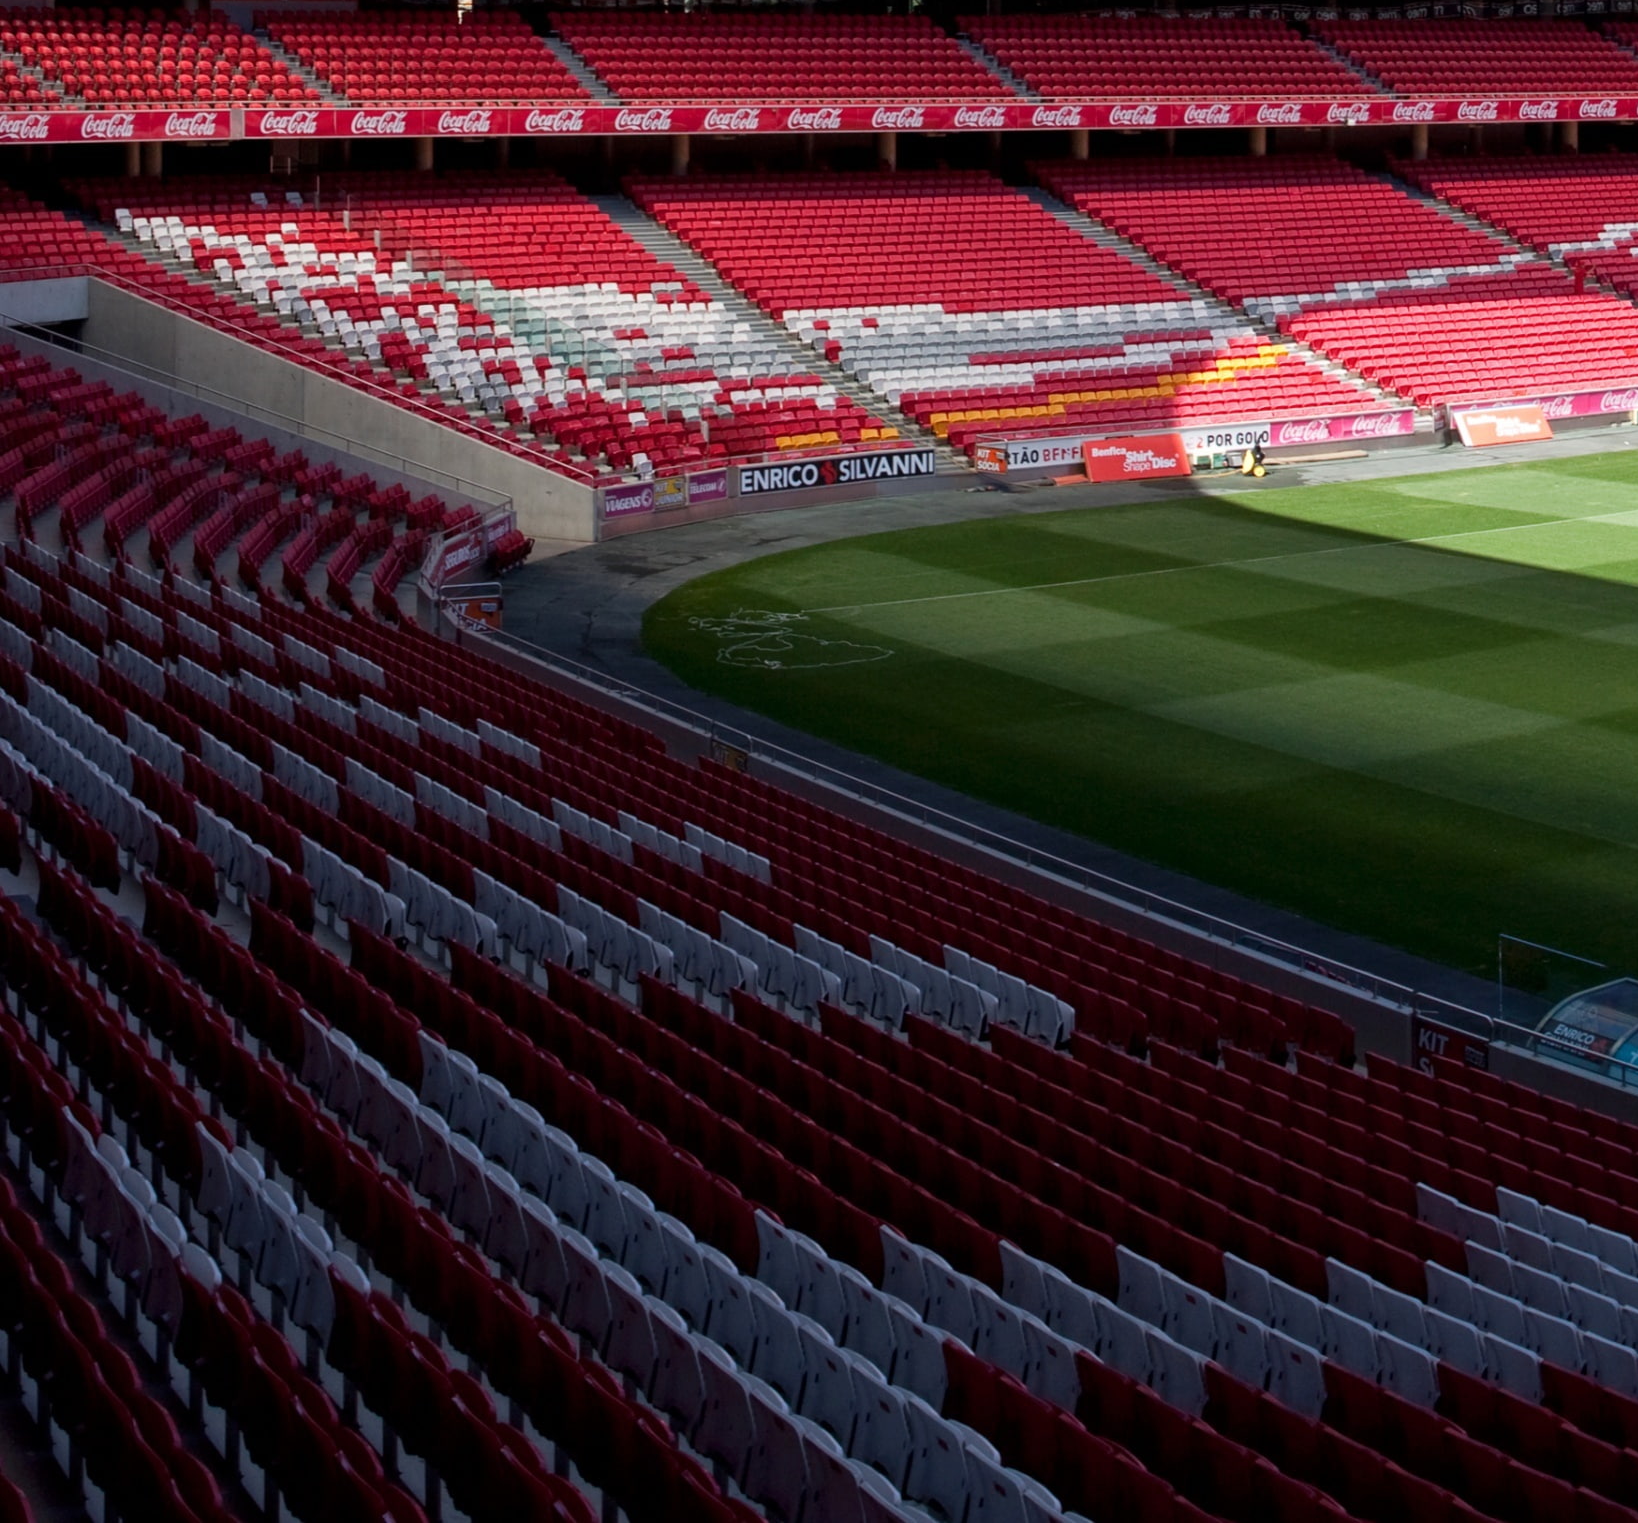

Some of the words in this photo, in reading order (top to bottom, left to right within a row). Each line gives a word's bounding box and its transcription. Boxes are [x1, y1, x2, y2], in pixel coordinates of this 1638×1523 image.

[352, 111, 406, 133] Coca-Cola
[1257, 104, 1301, 122] Coca-Cola
[1279, 419, 1331, 443] Coca-Cola
[1352, 412, 1401, 436] Coca-Cola
[1207, 434, 1233, 448] POR
[1091, 447, 1126, 458] Benfica
[1125, 450, 1155, 462] Shirt
[1152, 456, 1177, 468] Disc
[741, 463, 818, 494] ENRICO
[839, 451, 934, 482] SILVANNI
[1418, 1027, 1449, 1056] KIT
